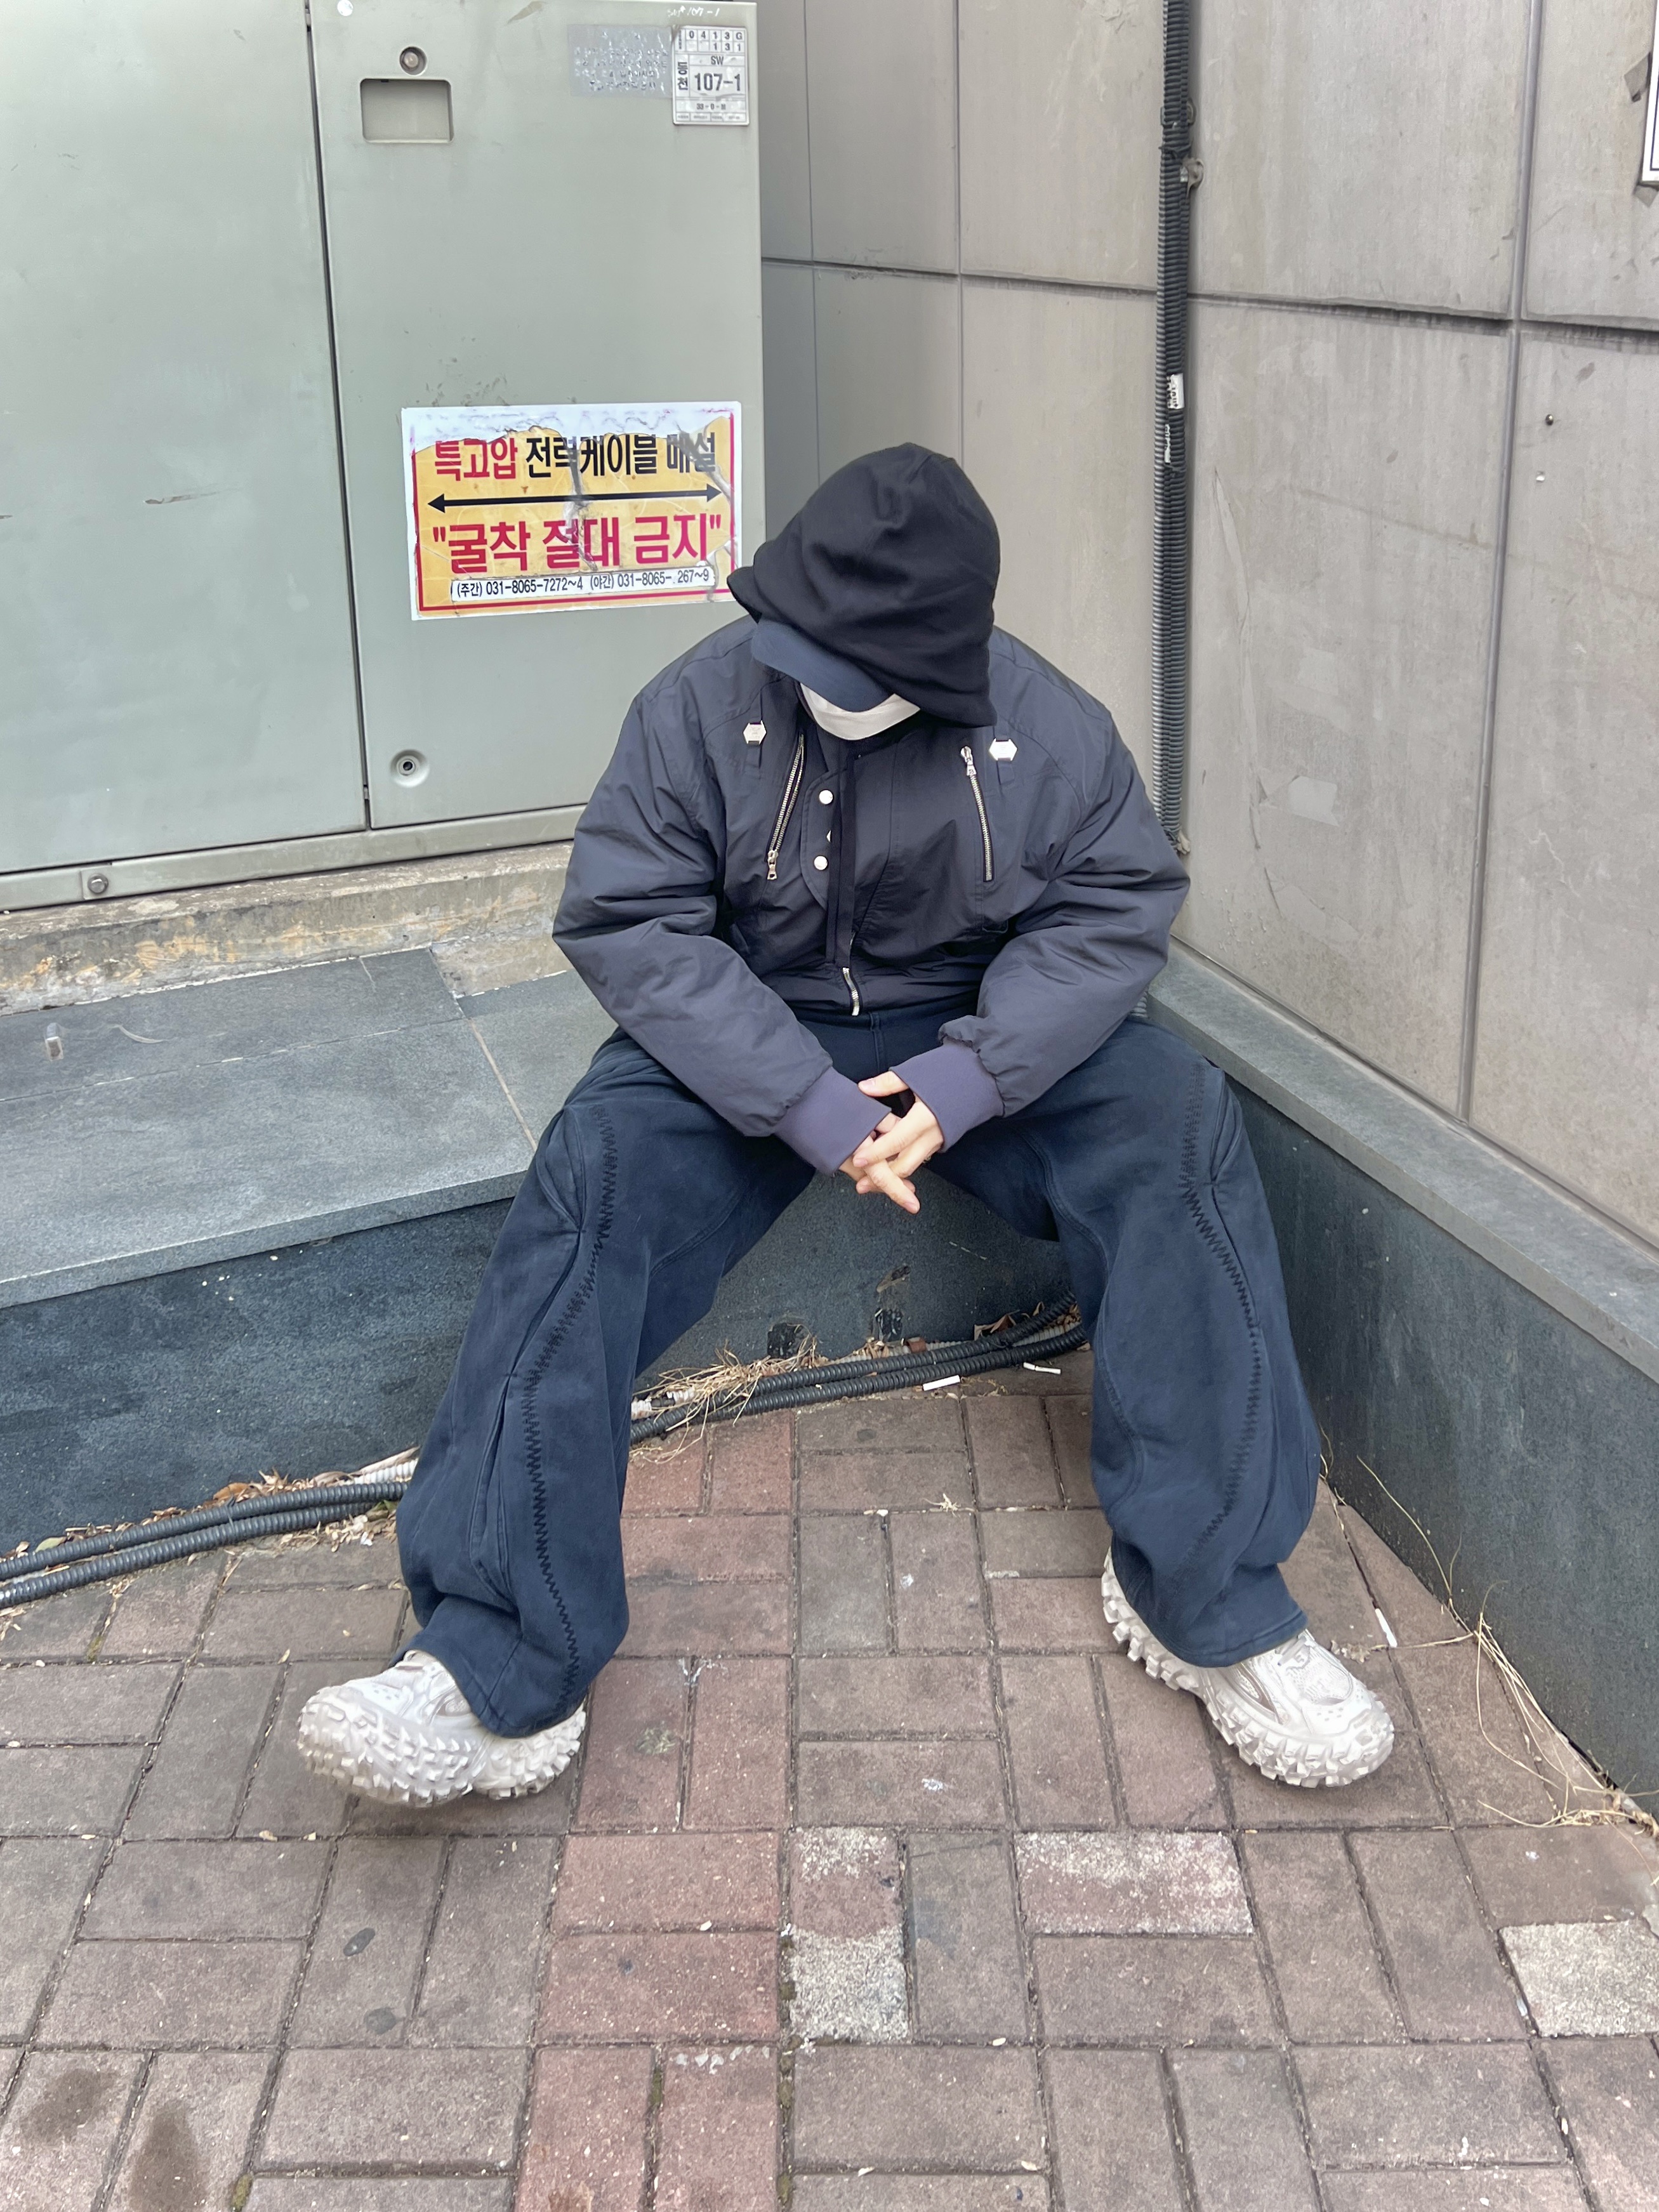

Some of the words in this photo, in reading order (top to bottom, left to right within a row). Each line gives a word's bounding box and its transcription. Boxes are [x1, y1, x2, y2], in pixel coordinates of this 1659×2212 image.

[711, 56, 724, 65] SW
[677, 62, 688, 90] 동천
[694, 73, 741, 91] 107-1
[435, 438, 518, 481] 특고압
[433, 521, 531, 574] "굴착
[543, 517, 620, 569] 절대
[634, 513, 721, 564] 금지"
[457, 581, 482, 597] (주간)
[486, 577, 583, 595] 031-8065-7272~4
[590, 574, 614, 589] (야간)
